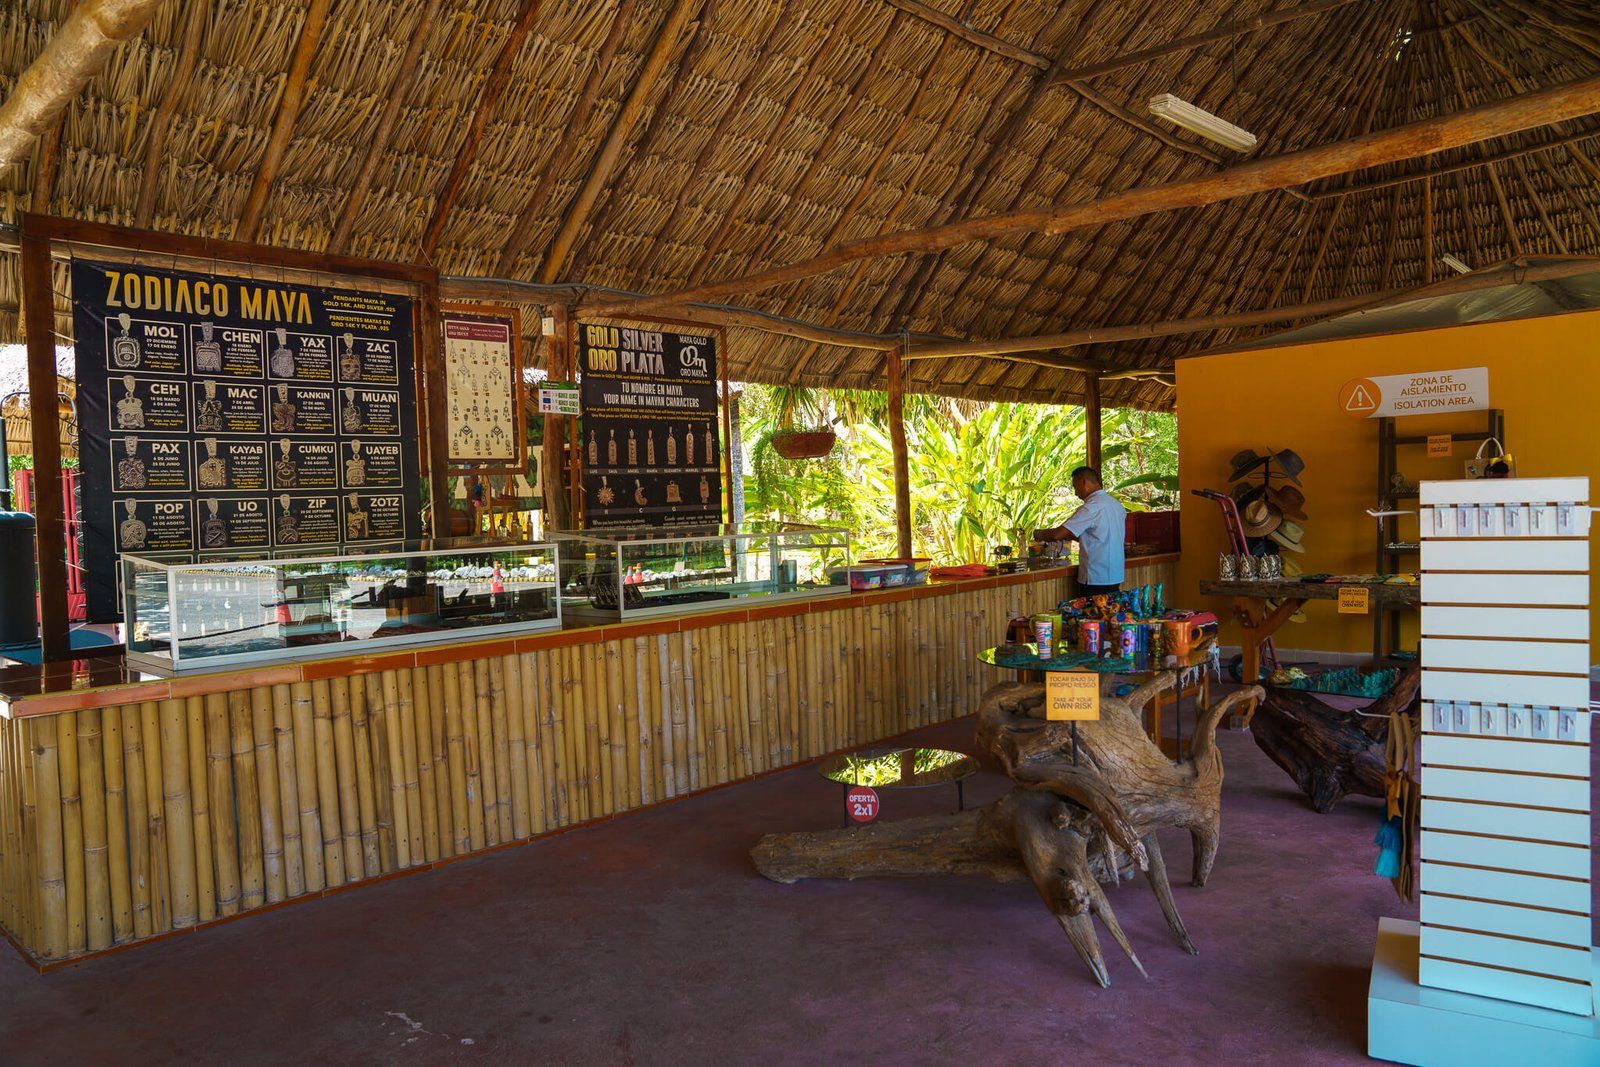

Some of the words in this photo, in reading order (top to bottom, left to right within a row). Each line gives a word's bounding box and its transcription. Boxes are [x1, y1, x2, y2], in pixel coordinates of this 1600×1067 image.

[105, 271, 228, 317] ZODIACO
[240, 286, 312, 324] MAYA
[144, 325, 178, 338] MOL
[223, 331, 260, 343] CHEN
[300, 337, 325, 348] YAX
[586, 326, 619, 348] GOLD
[622, 328, 663, 352] SILVER
[680, 336, 693, 344] MAYA
[693, 337, 706, 345] GOLD
[367, 342, 390, 353] ZAC
[588, 348, 617, 372] ORO
[621, 351, 664, 375] PLATA
[1410, 377, 1437, 386] ZONA
[1440, 375, 1453, 383] DE
[151, 384, 179, 395] CEH
[228, 388, 258, 399] MAC
[622, 382, 629, 393] TU
[631, 383, 656, 394] NOMBRE
[657, 384, 665, 394] EN
[667, 385, 682, 395] MAYA
[1400, 383, 1467, 396] AISLAMIENTO
[297, 391, 330, 399] KANKIN
[362, 393, 396, 402] MUAN
[604, 393, 619, 404] YOUR
[621, 395, 636, 405] NAME
[639, 396, 644, 405] IN
[646, 396, 665, 406] MAYAN
[666, 397, 699, 407] CHARACTERS
[1394, 398, 1445, 410] ISOLATION
[1448, 397, 1474, 405] AREA
[152, 443, 180, 454] PAX
[366, 446, 398, 454] UAYEB
[238, 502, 257, 511] UO
[308, 499, 326, 508] ZIP
[370, 498, 399, 507] ZOTZ
[155, 504, 183, 513] POP
[854, 804, 873, 816] 2x1
